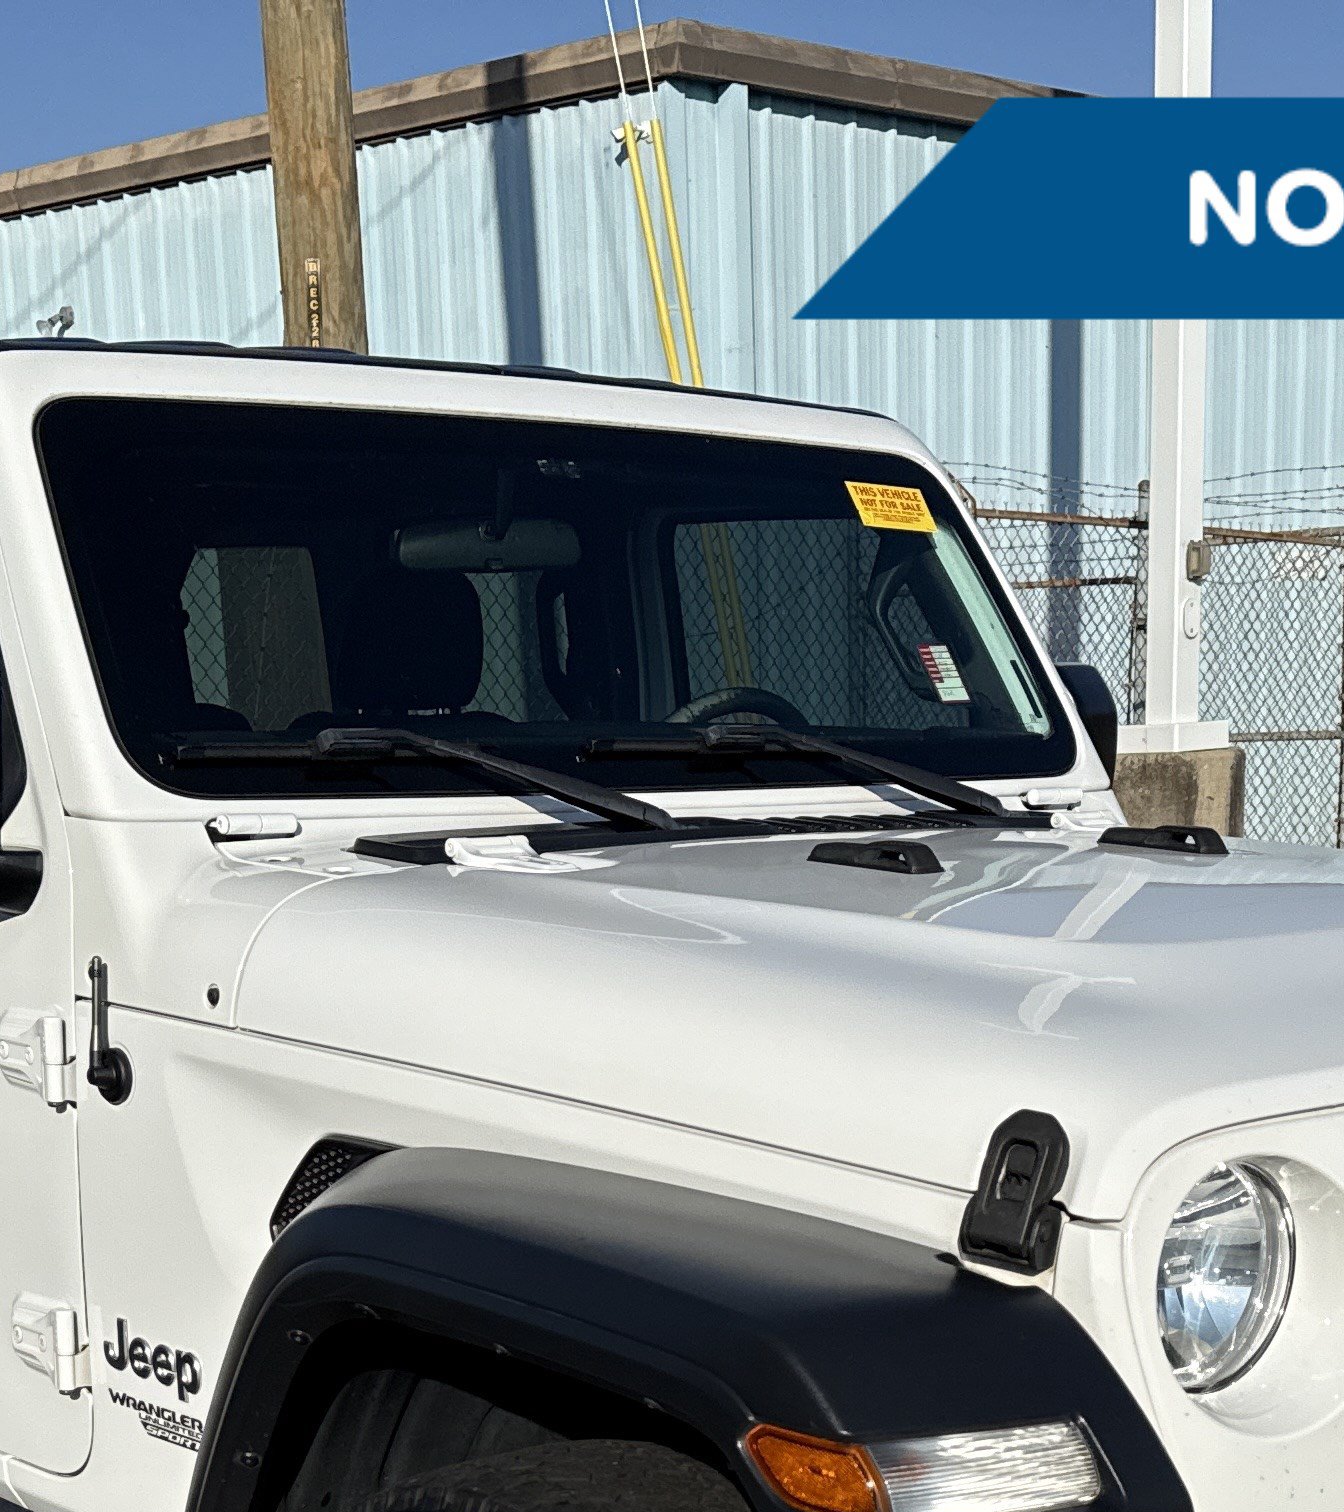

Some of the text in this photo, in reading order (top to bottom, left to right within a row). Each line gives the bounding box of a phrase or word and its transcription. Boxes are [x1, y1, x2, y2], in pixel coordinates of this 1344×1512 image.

[851, 485, 921, 502] THIS VEHICLE
[859, 497, 876, 507] NOT
[879, 500, 898, 509] FOR
[900, 502, 923, 512] SALE
[103, 1317, 202, 1403] Jeep
[108, 1388, 204, 1433] WRANGLER
